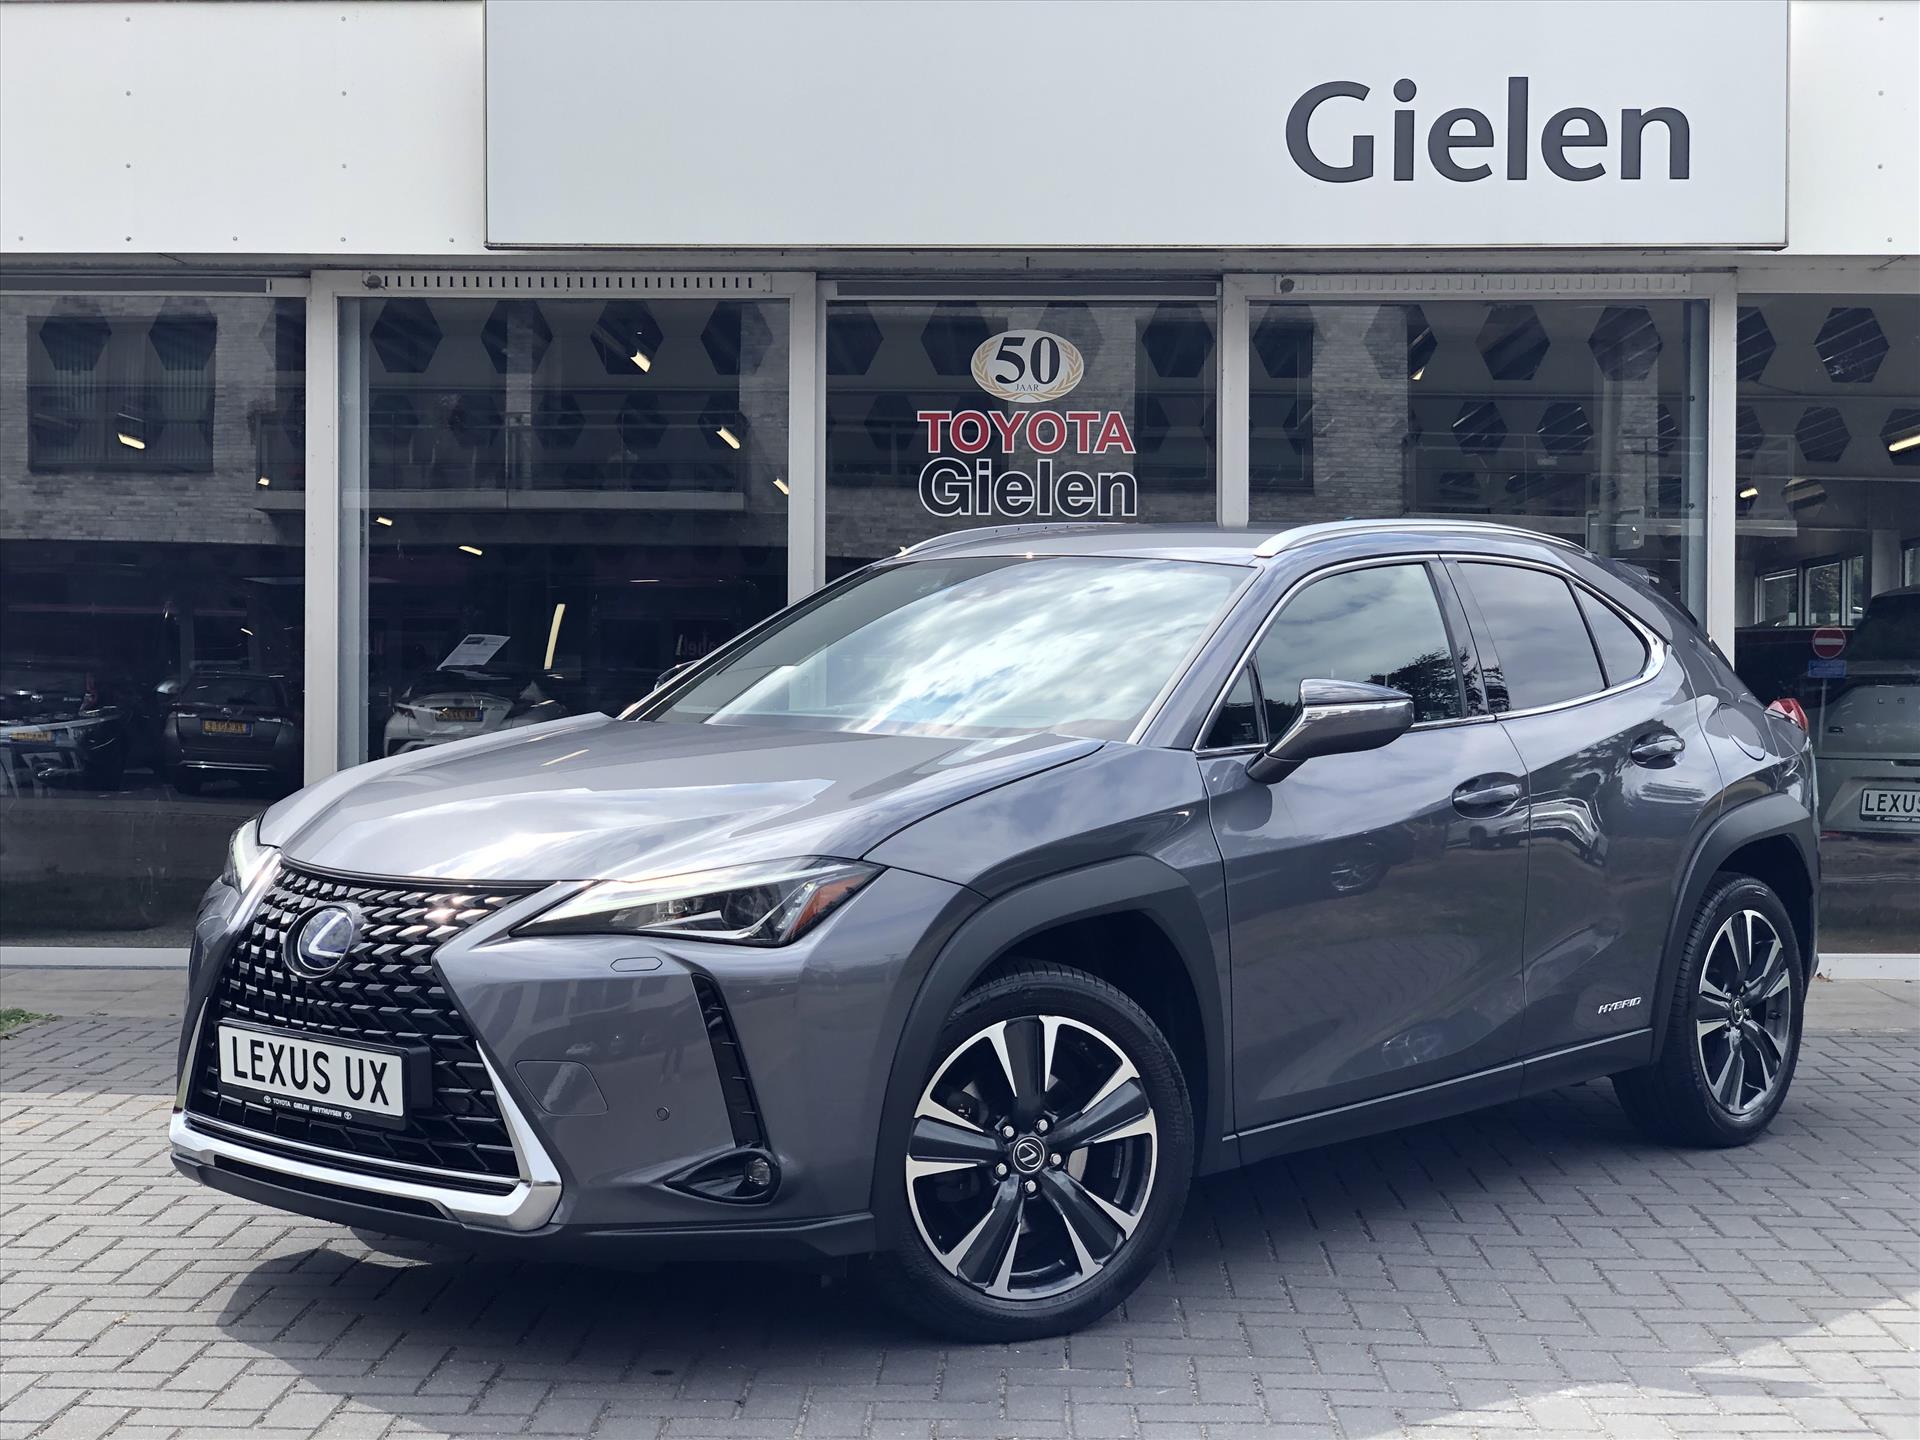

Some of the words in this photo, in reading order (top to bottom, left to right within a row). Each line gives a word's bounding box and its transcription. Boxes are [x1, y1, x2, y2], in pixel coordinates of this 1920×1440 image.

[1285, 76, 1690, 183] Gielen
[994, 336, 1061, 385] 50
[1015, 383, 1039, 392] JAAR
[917, 410, 1137, 454] TOYOTA
[918, 456, 1138, 517] Gielen
[1865, 793, 1920, 813] LEXU
[1597, 996, 1642, 1015] HYBRID
[232, 1036, 331, 1095] LEXUS
[345, 1056, 389, 1106] UX
[272, 1097, 291, 1107] TOYOTA
[293, 1102, 310, 1111] GIELEN
